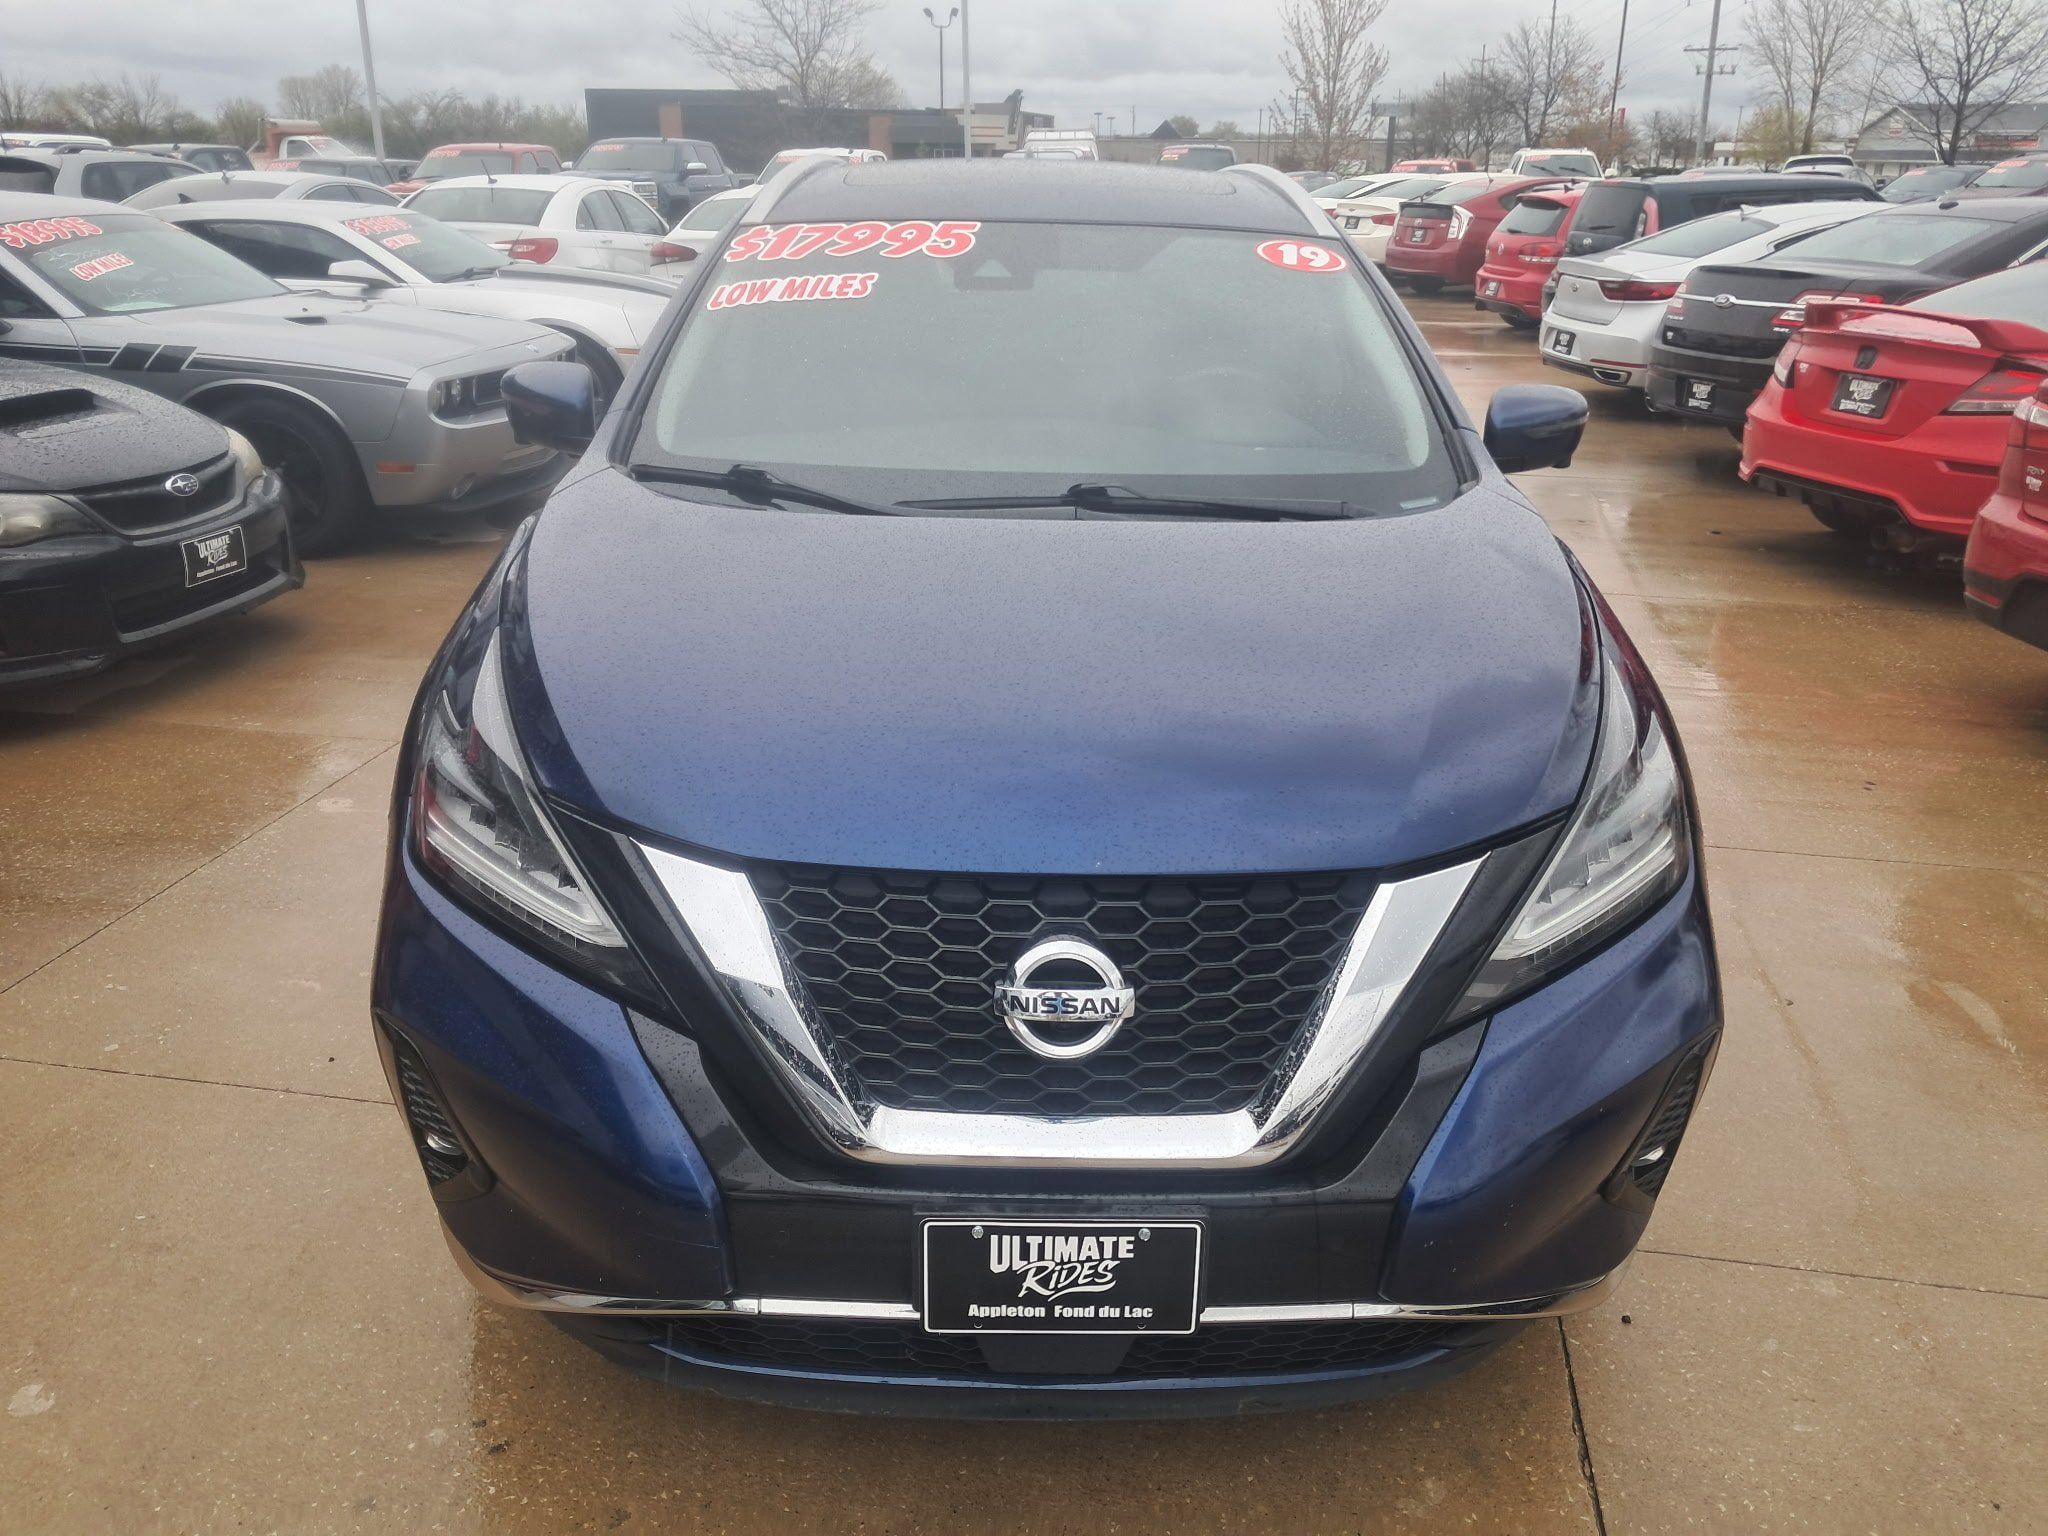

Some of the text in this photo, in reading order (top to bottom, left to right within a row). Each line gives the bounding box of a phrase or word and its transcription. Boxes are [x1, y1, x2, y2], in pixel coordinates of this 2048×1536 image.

[724, 221, 981, 262] $17995
[1277, 243, 1331, 268] 19
[70, 252, 134, 280] LOW MILES
[707, 273, 878, 309] LOW MILES
[1010, 995, 1120, 1015] NISSAN
[990, 1235, 1135, 1273] ULTIMATE
[968, 1304, 1154, 1318] Appleton Fond du Lac
